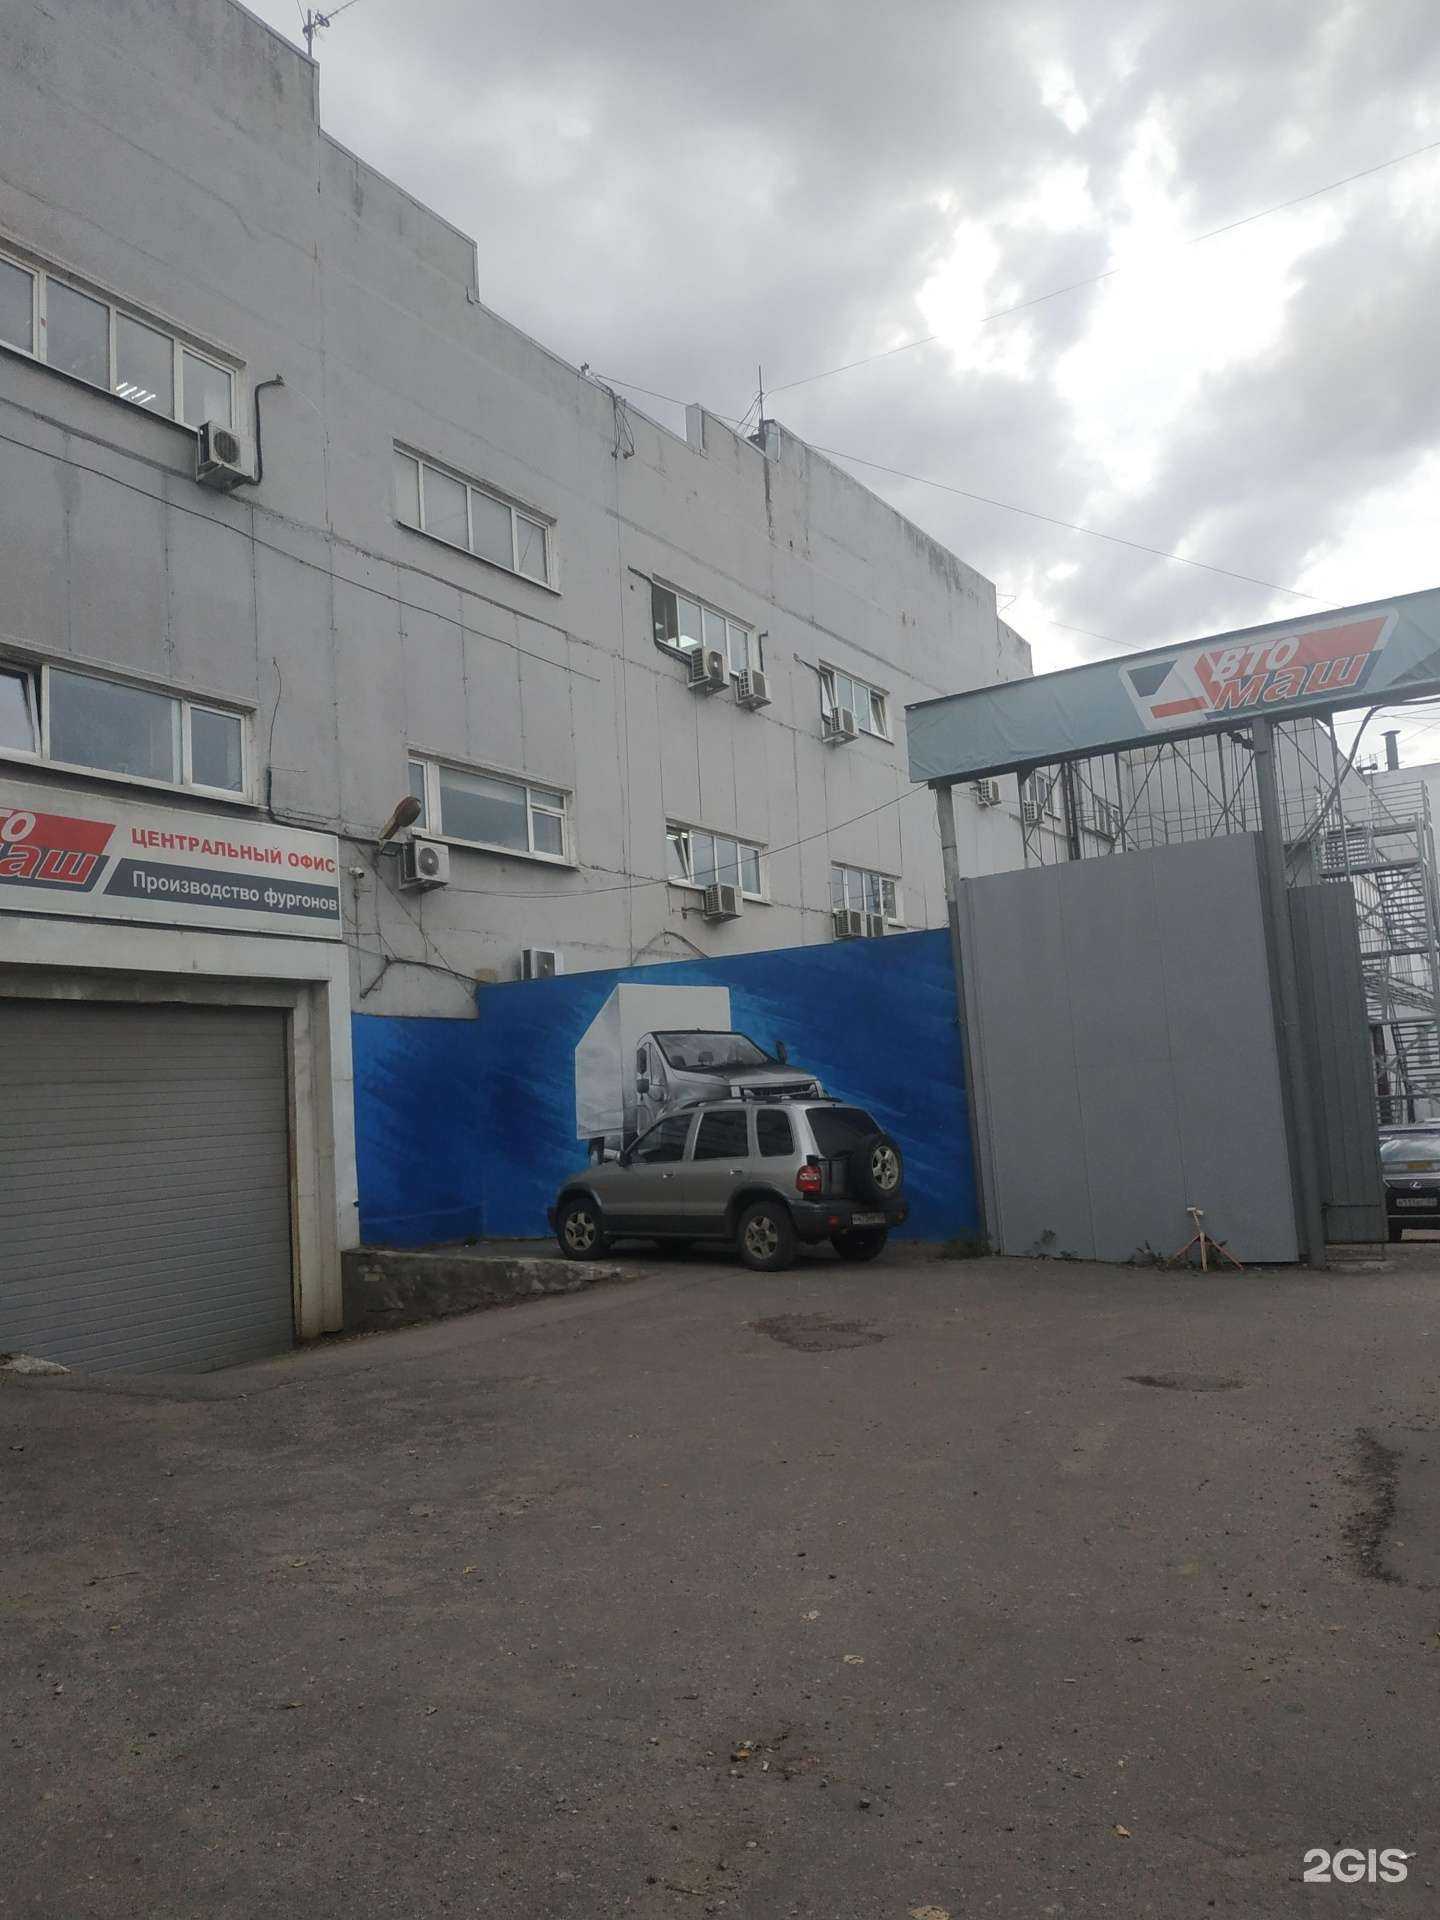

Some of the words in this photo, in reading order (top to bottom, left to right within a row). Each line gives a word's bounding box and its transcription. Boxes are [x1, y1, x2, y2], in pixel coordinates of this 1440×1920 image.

[131, 827, 282, 866] ЦЕНТРАЛЬНЫЙ
[287, 852, 336, 874] ОФИС
[132, 869, 260, 901] Производство
[264, 887, 338, 911] фургонов
